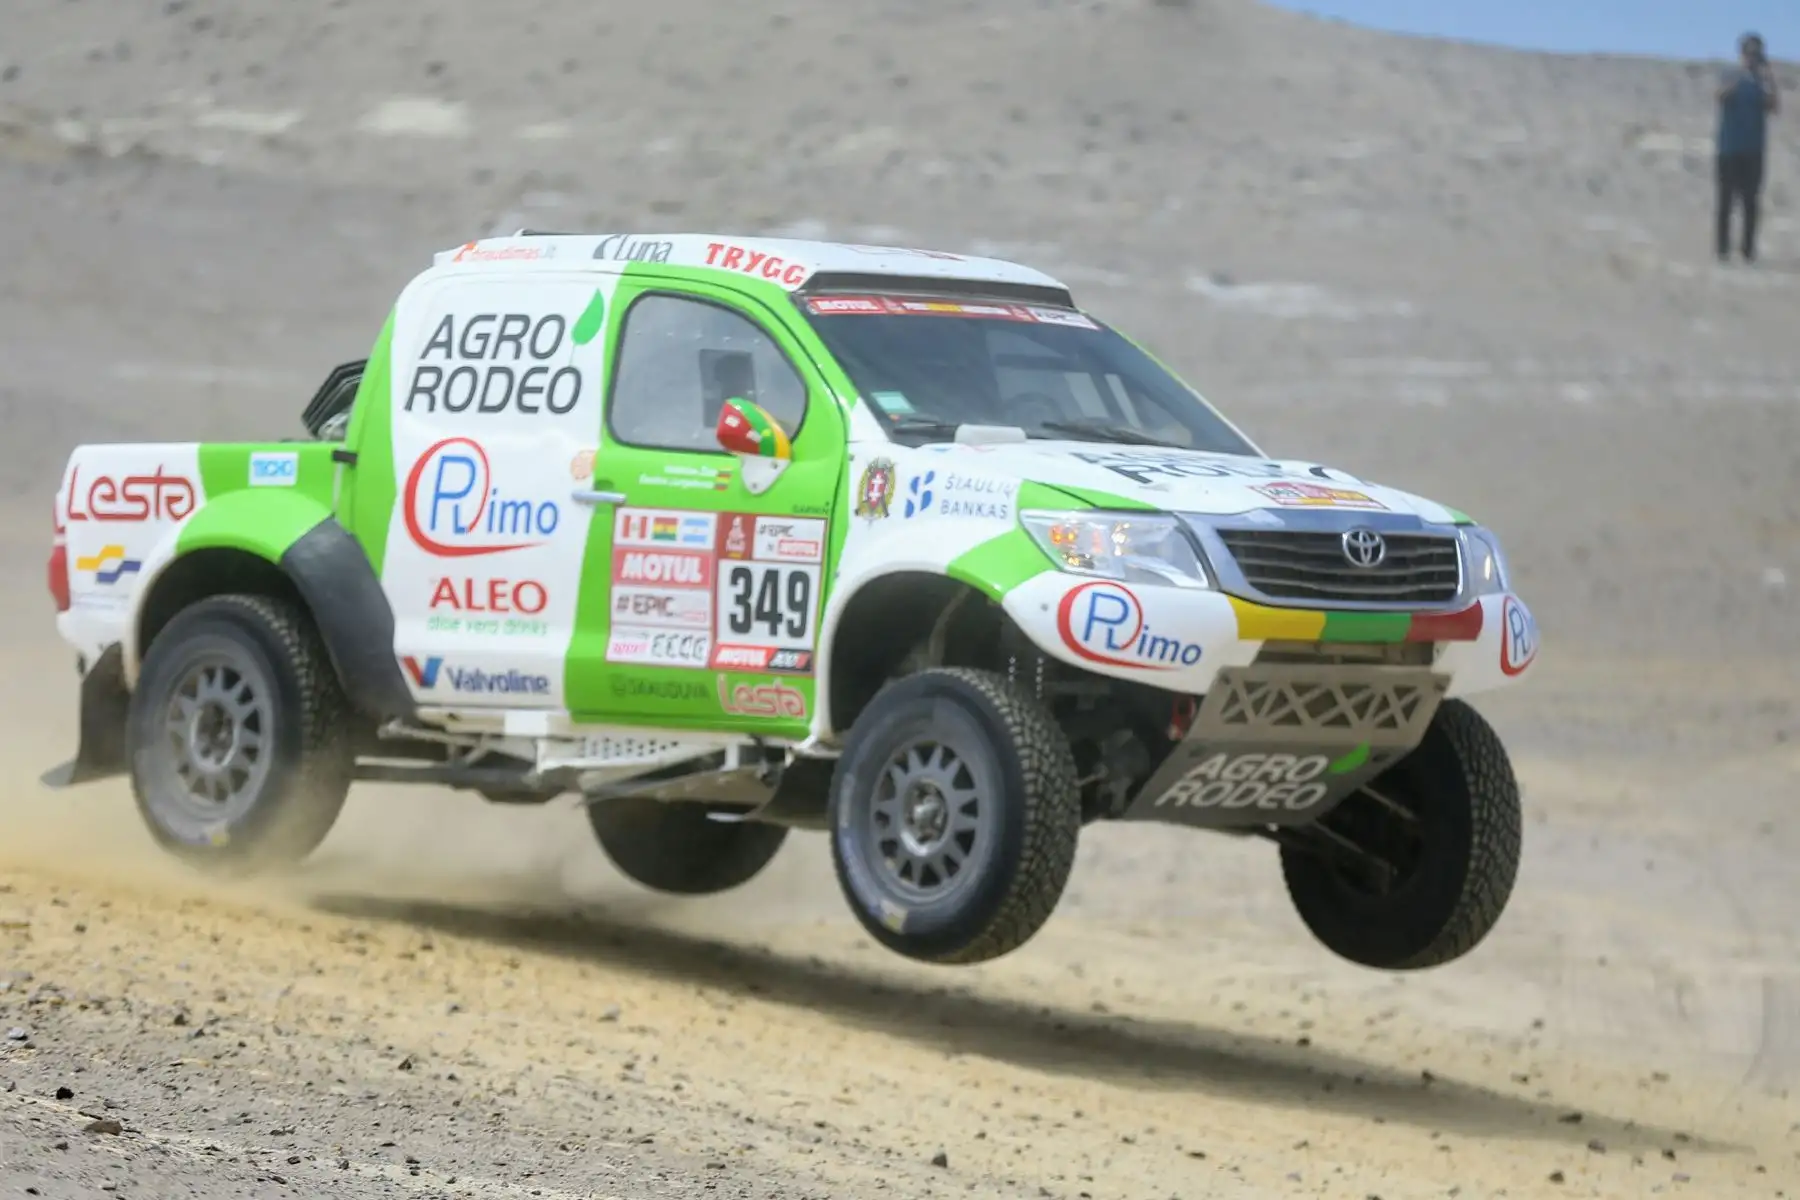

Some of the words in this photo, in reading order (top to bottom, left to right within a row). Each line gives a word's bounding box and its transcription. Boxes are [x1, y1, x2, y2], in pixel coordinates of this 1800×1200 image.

[614, 234, 673, 263] Luna
[706, 243, 807, 286] TRYGG
[420, 314, 567, 360] AGRO
[404, 366, 582, 414] RODEO
[68, 463, 196, 521] Lesta
[941, 500, 1008, 519] BANKAS
[621, 552, 704, 584] MOTUL
[429, 576, 549, 614] ALEO
[729, 566, 810, 639] 349
[445, 664, 550, 696] Valvoline
[718, 673, 807, 720] Lesta
[1185, 752, 1329, 783] AGRO
[1154, 780, 1328, 810] RODEO
